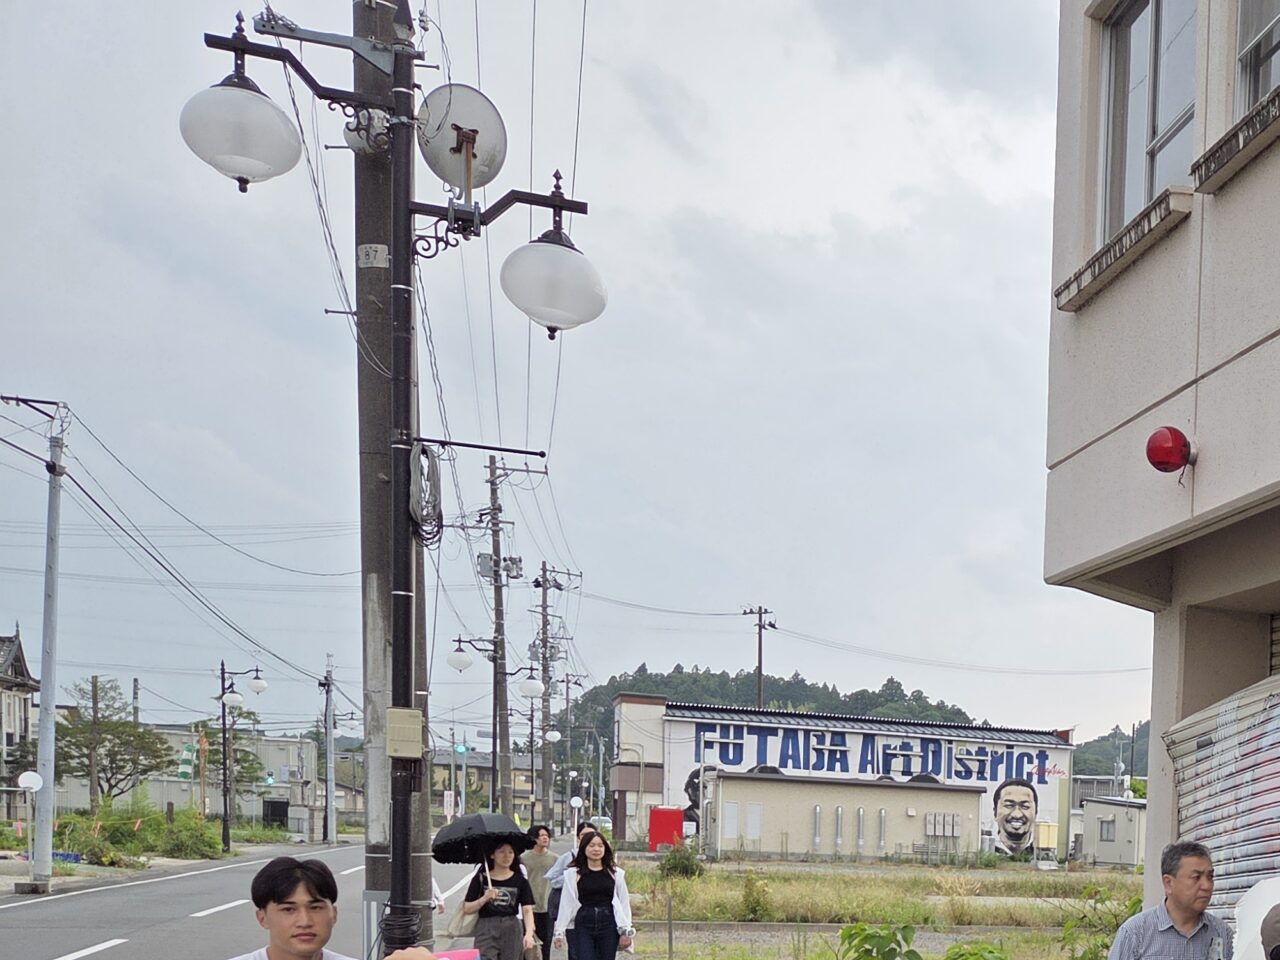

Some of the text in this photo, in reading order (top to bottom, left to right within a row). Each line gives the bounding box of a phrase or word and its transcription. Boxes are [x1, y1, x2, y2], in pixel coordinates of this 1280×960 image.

[694, 722, 1049, 785] FUTABA Art District
